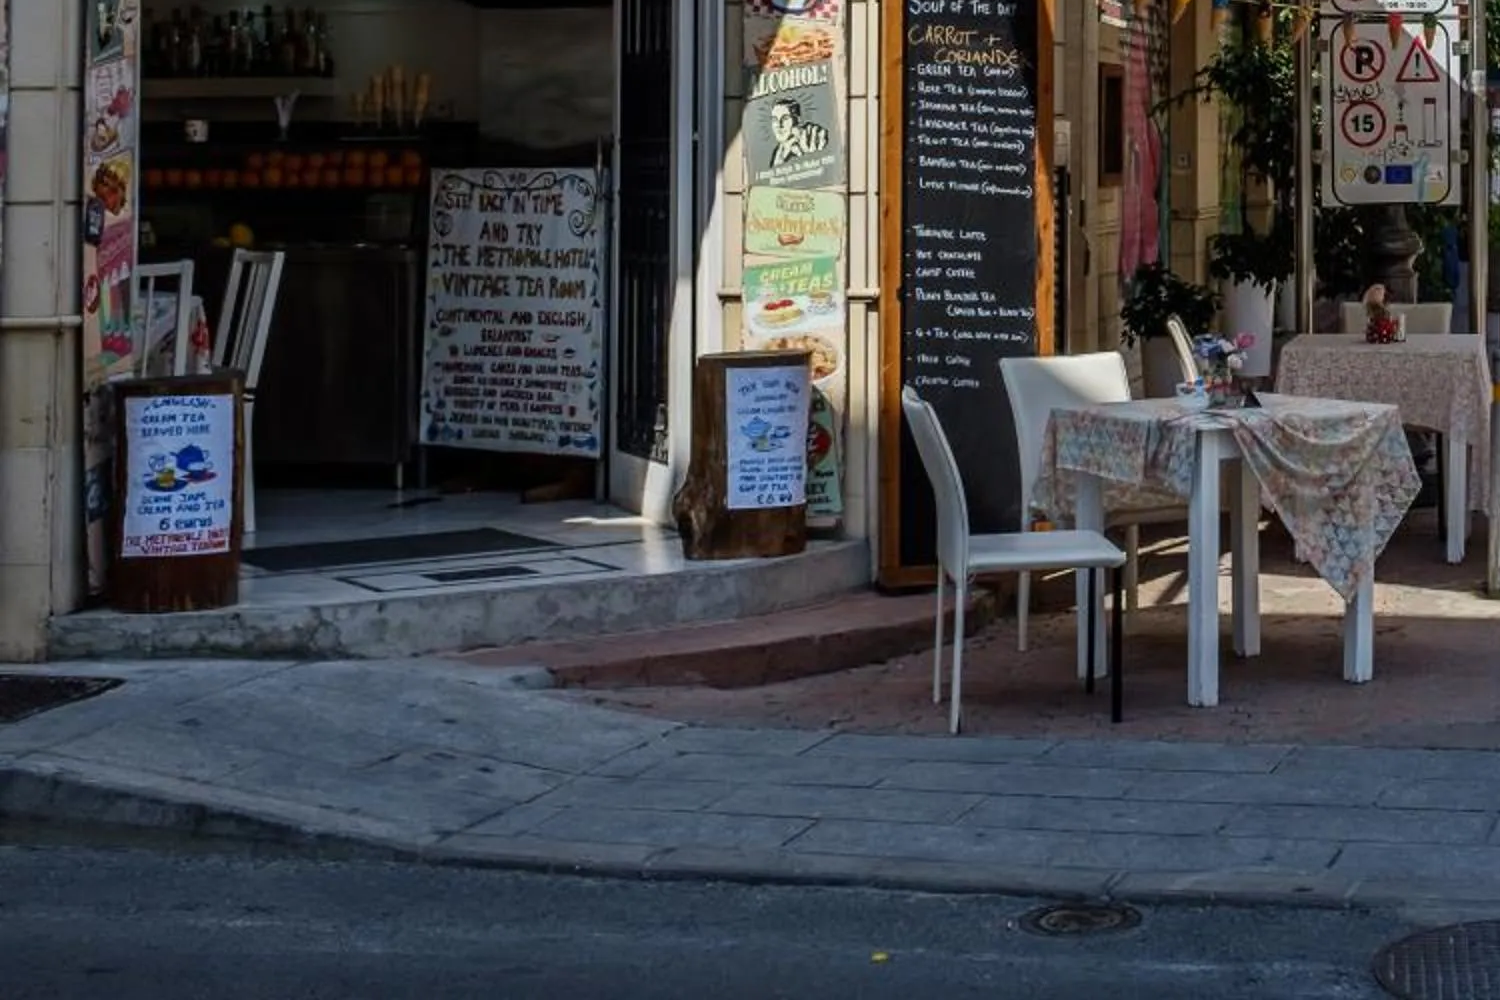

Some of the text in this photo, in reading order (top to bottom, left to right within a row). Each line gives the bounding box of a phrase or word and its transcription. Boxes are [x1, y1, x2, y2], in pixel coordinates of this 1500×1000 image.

[949, 0, 965, 15] OF
[969, 0, 992, 16] THE
[997, 2, 1017, 17] DAY
[907, 23, 979, 47] CARROT
[917, 63, 951, 76] GREEN
[958, 65, 977, 78] TEA
[1350, 114, 1375, 133] 15
[531, 193, 564, 216] TIME
[479, 220, 544, 246] AND TRY
[442, 243, 471, 267] THE
[476, 246, 551, 269] METROPOLE
[762, 261, 814, 281] CREAM
[441, 273, 587, 299] VINTAGE TEA ROOM
[788, 273, 834, 294] TEAS
[435, 309, 586, 327] CONTINENTAL AND ENGLISH
[141, 411, 206, 425] CREAM TEA
[141, 423, 212, 438] SERVED HERE
[136, 499, 226, 516] CREAM AND TEA
[158, 515, 214, 532] 6 euros
